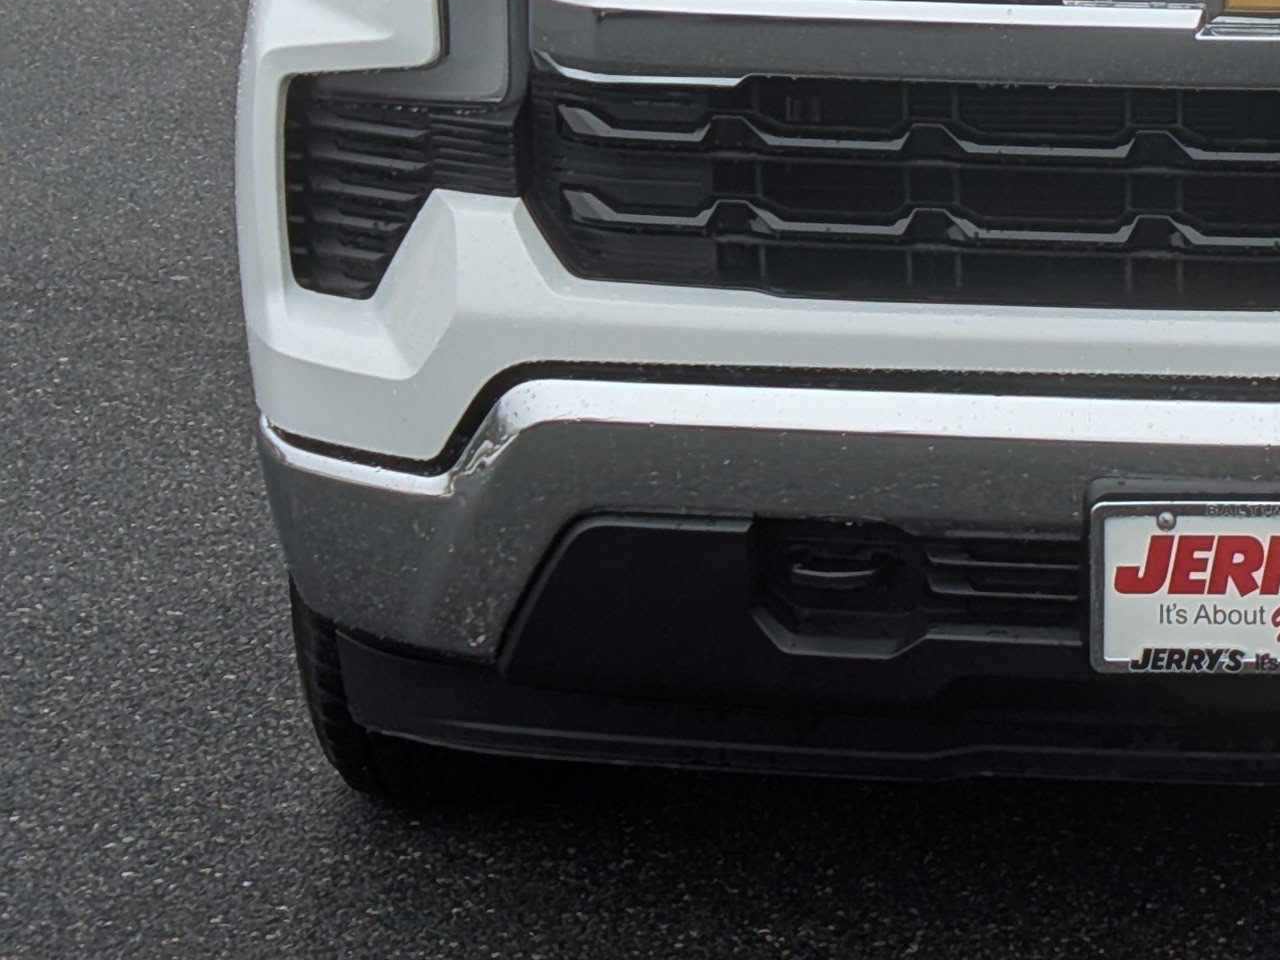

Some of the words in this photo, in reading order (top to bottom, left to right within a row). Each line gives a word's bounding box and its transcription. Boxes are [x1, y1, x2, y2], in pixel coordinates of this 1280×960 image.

[1158, 603, 1188, 626] It's
[1193, 604, 1267, 626] About
[1130, 648, 1246, 672] JERRY'S
[1254, 653, 1279, 671] It's
